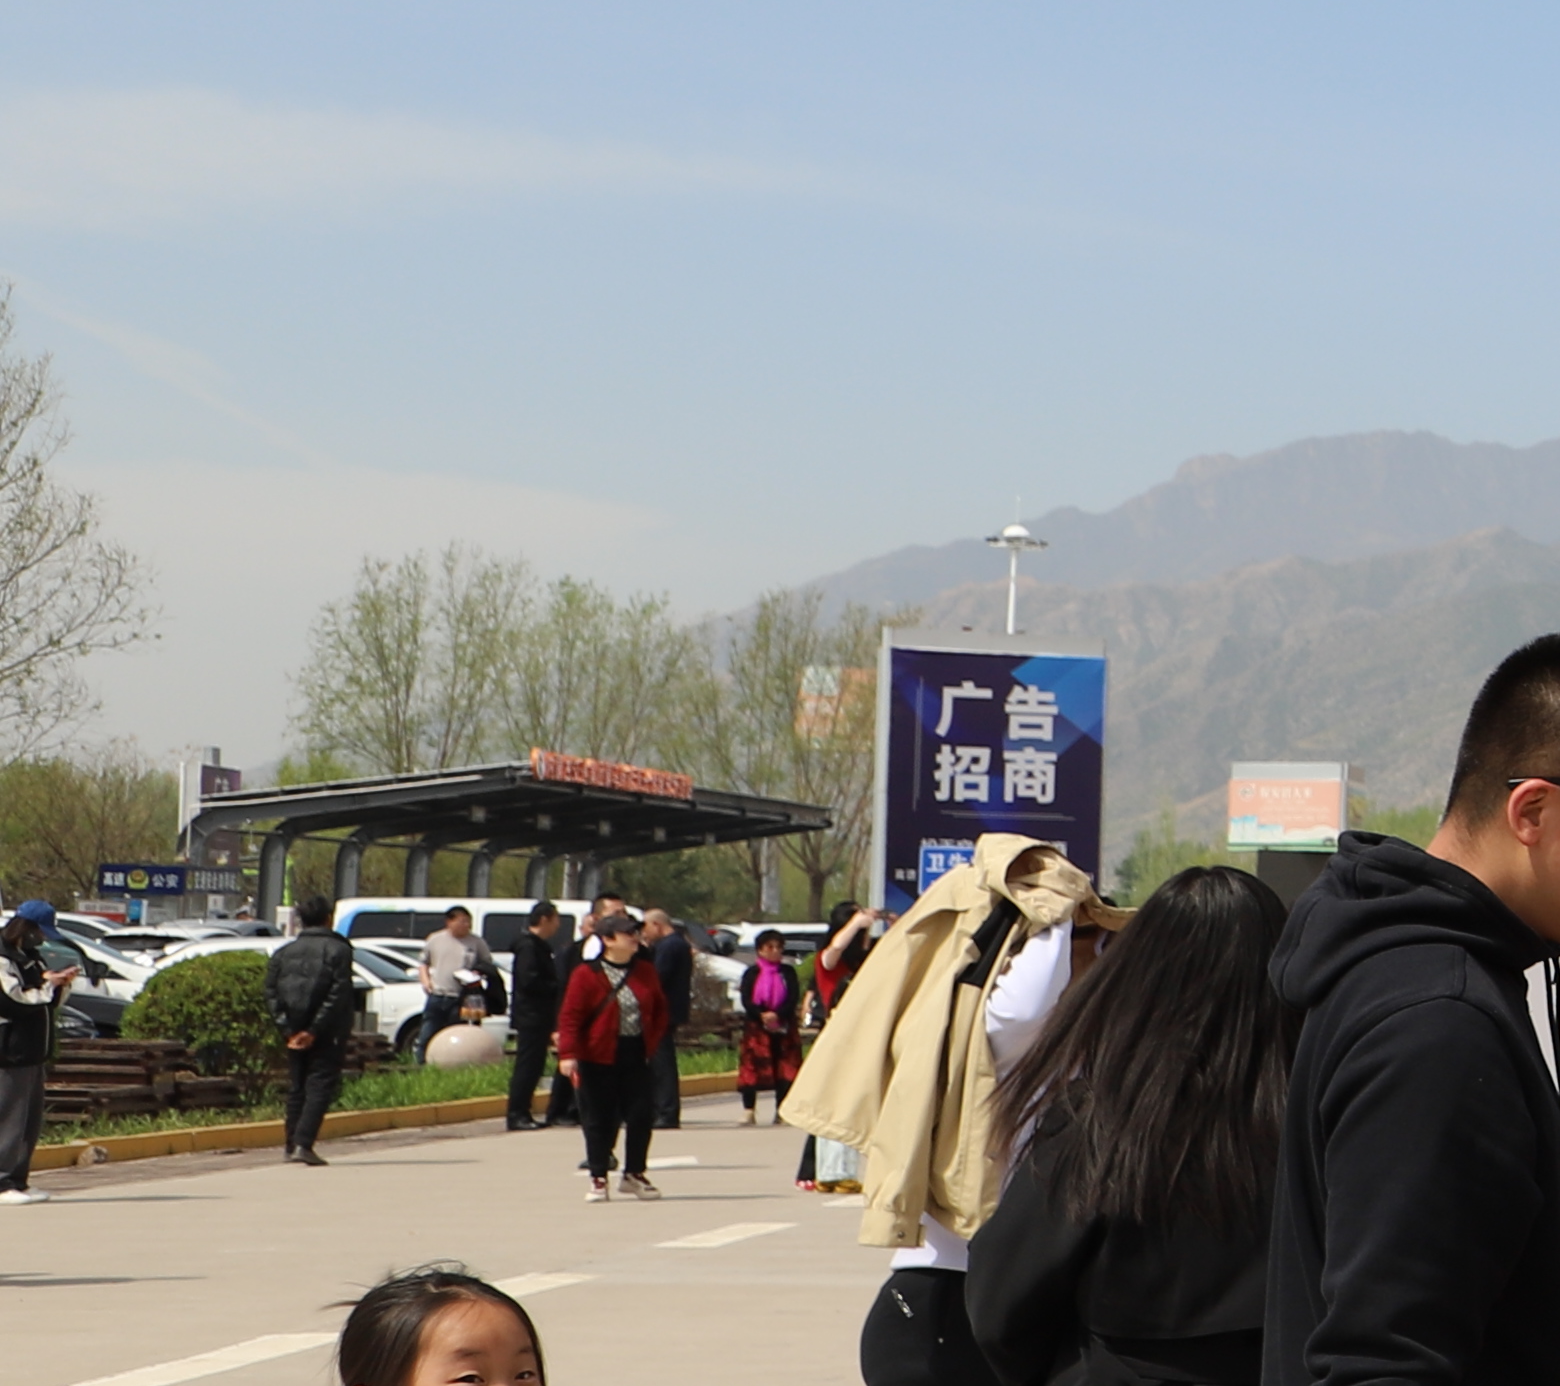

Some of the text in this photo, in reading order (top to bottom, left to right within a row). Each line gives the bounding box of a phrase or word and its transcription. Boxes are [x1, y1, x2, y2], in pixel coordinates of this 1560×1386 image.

[935, 679, 1059, 743] 广告
[933, 744, 1059, 804] 招商
[151, 873, 179, 889] 公安
[926, 852, 976, 874] 卫生
